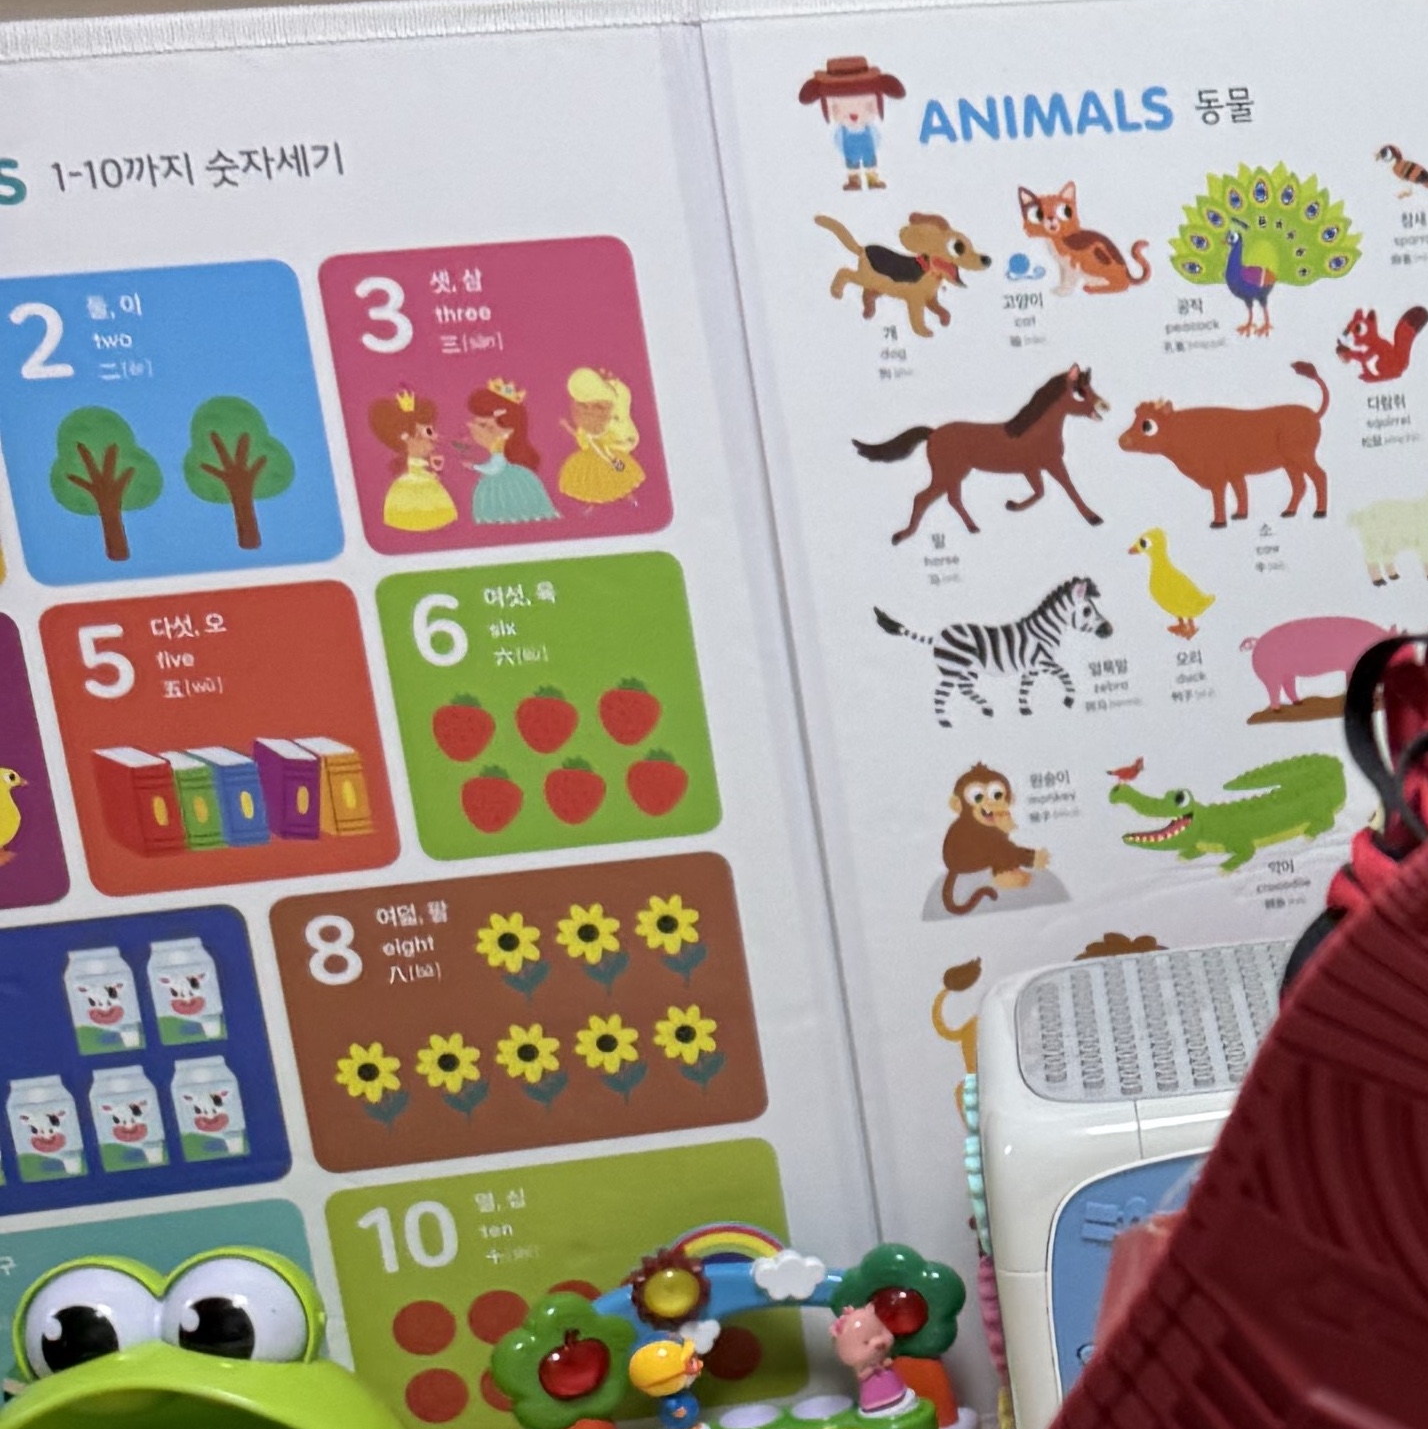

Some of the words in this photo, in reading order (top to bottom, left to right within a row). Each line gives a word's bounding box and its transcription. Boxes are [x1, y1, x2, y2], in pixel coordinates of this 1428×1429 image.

[919, 85, 1175, 145] ANIMALS
[1195, 87, 1255, 126] 동물
[51, 151, 195, 192] 1-10까지
[205, 141, 345, 189] 숫자세기
[120, 291, 143, 317] 이
[355, 276, 414, 354] 3
[435, 305, 492, 324] three
[10, 301, 75, 380] 2
[93, 333, 132, 350] two
[150, 613, 200, 640] 다섯,
[204, 612, 228, 634] 오
[412, 592, 469, 667] 6
[490, 619, 517, 639] six
[78, 623, 136, 700] 5
[156, 650, 195, 670] five
[305, 914, 363, 986] 8
[382, 934, 435, 958] eight
[357, 1200, 459, 1274] 10
[481, 1223, 513, 1239] ten
